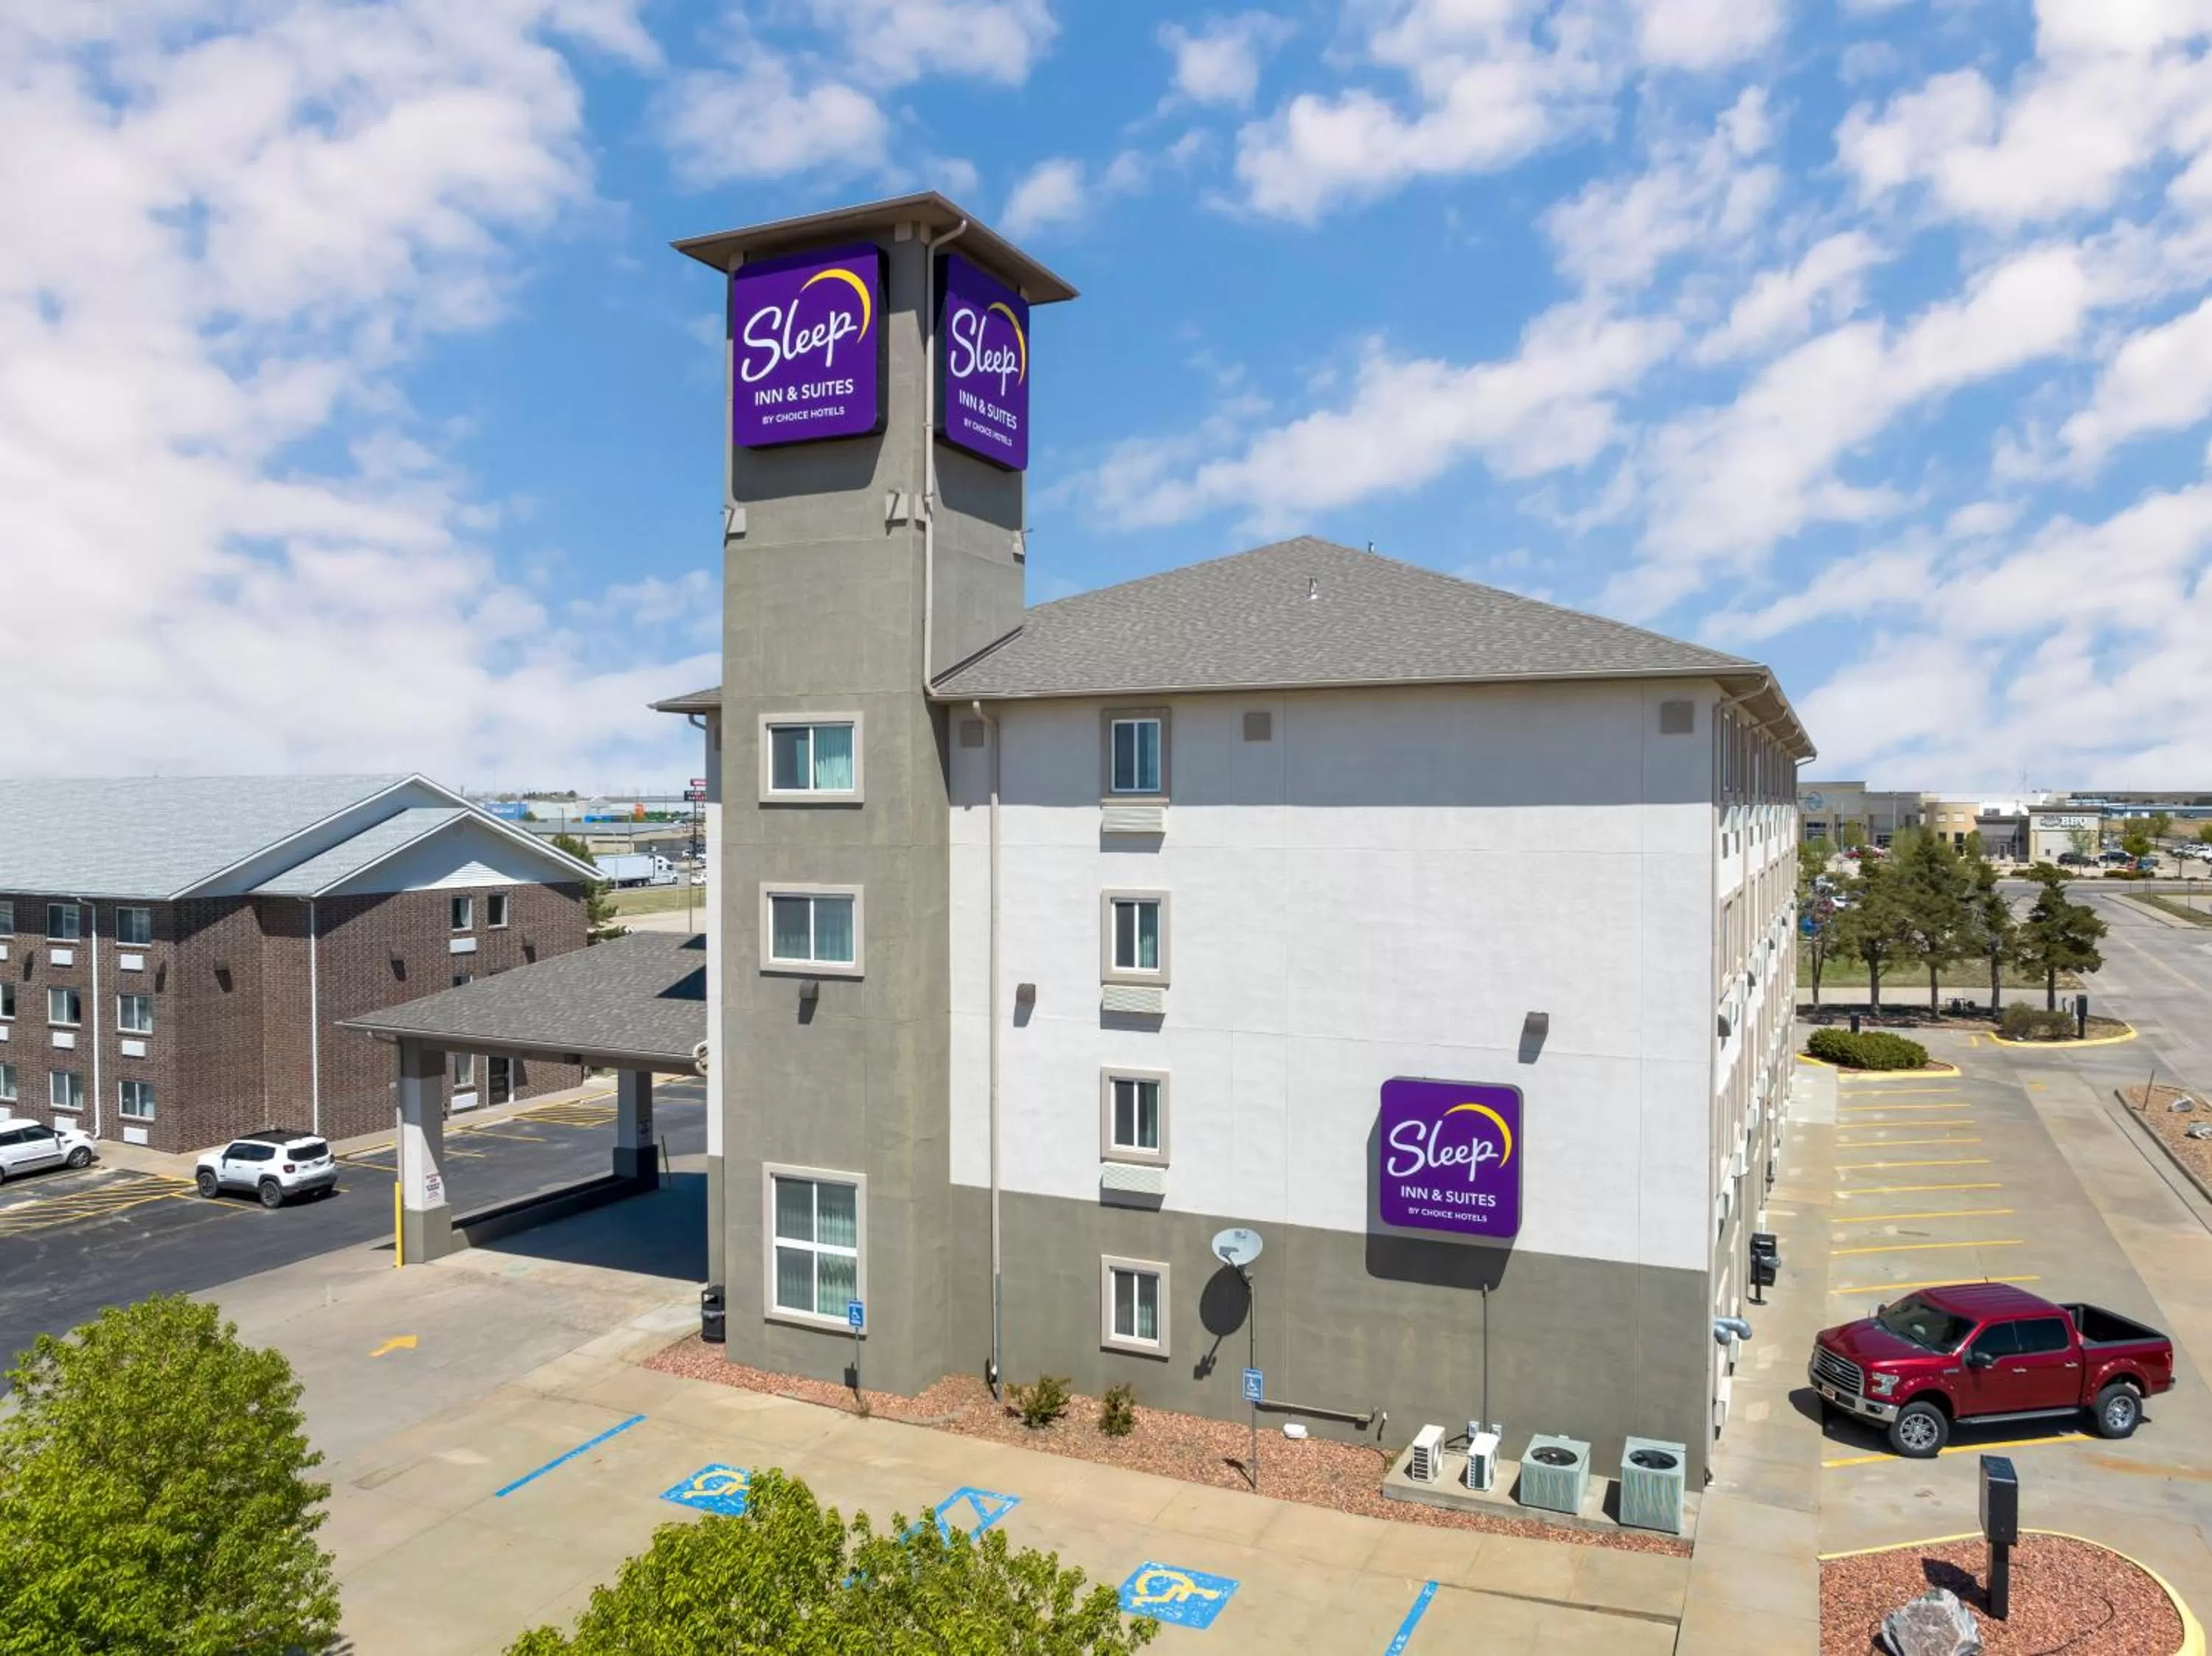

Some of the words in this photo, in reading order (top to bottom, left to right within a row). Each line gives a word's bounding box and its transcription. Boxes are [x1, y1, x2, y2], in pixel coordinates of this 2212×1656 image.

[741, 299, 858, 383] Sleep
[950, 308, 1018, 397] Sleep
[754, 388, 783, 406] INN
[787, 386, 798, 401] &
[801, 378, 854, 399] SUITES
[762, 415, 774, 425] BY
[775, 411, 809, 422] CHOICE
[810, 406, 845, 418] HOTELS
[959, 389, 977, 411] INN
[978, 398, 986, 416] &
[987, 403, 1017, 431] SUITES
[1387, 1120, 1499, 1183] Sleep
[1401, 1185, 1428, 1200] INN
[1431, 1189, 1442, 1202] &
[1446, 1190, 1496, 1207] SUITES
[1408, 1207, 1419, 1215] BY
[1421, 1208, 1453, 1219] CHOICE
[1455, 1212, 1487, 1222] HOTELS
